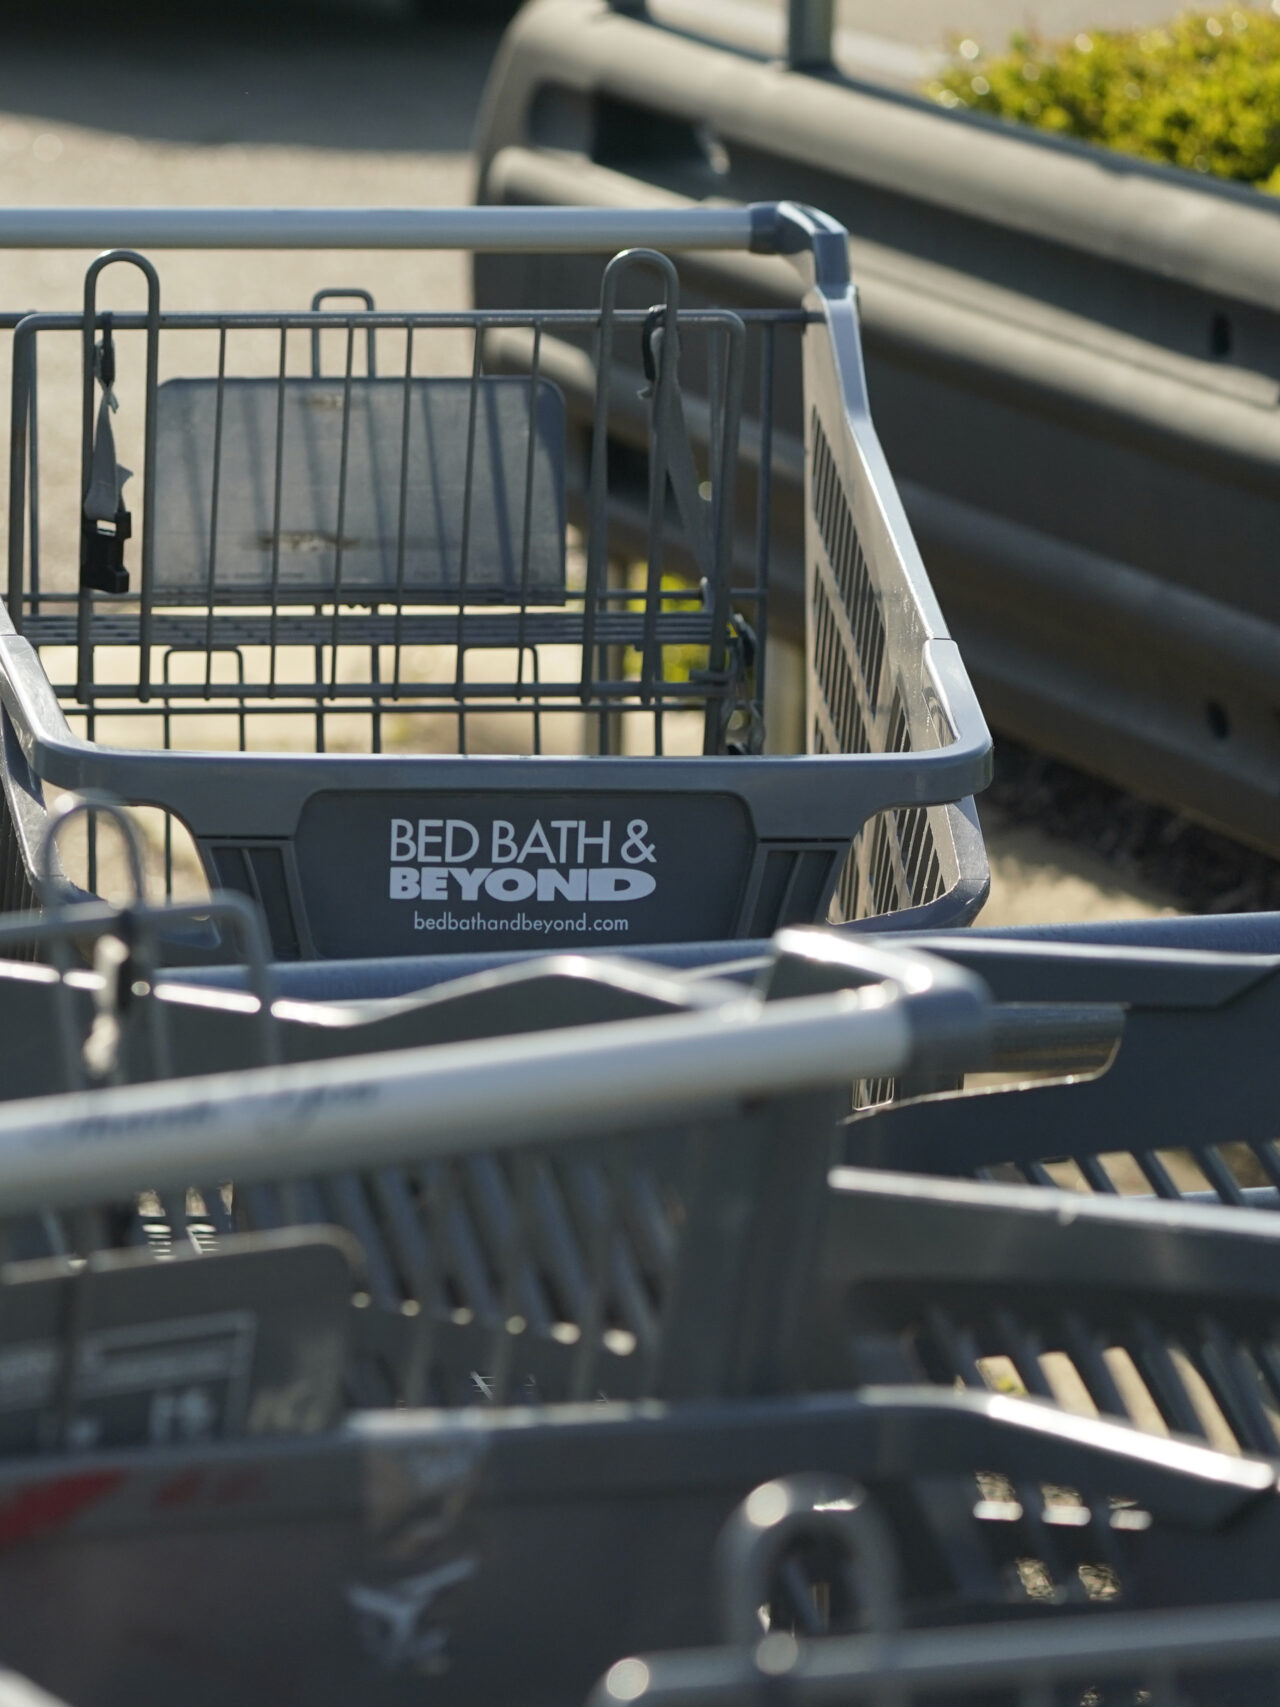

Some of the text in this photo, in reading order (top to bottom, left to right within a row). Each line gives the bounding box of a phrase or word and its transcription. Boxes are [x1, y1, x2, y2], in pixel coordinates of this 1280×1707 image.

[389, 818, 657, 864] BED BATH &
[389, 866, 657, 901] BEYOND
[413, 910, 629, 934] bedbathandbeyond.com
